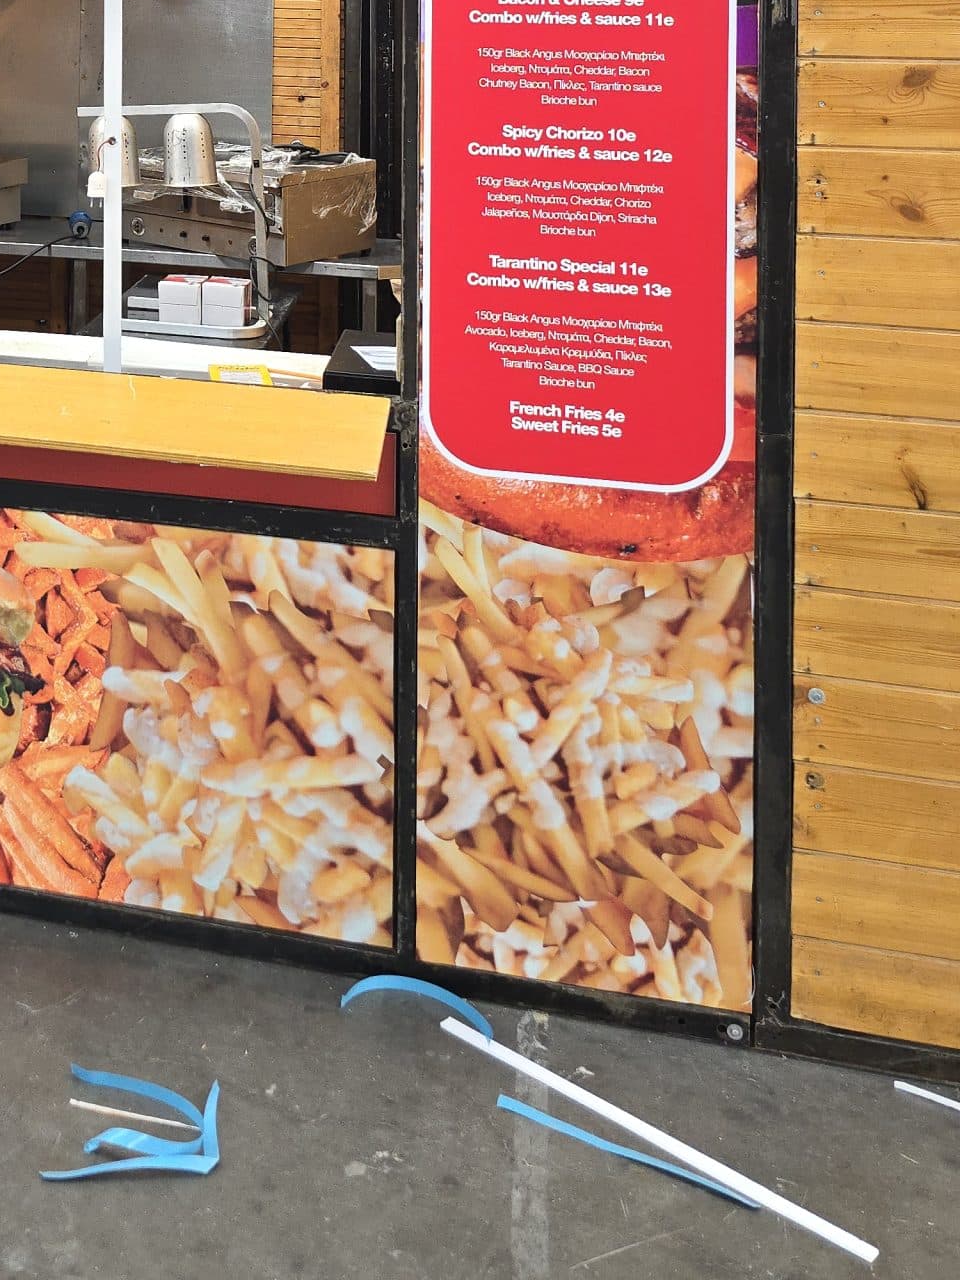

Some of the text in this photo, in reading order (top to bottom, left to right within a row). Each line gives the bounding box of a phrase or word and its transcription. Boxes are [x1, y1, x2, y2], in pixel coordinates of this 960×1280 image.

[469, 10, 674, 27] Combo w/fries & sauce 11e
[477, 47, 504, 60] 150gr
[505, 48, 531, 59] Black
[532, 49, 563, 61] Angus
[490, 64, 527, 75] Iceberg,
[573, 65, 617, 77] Cheddar,
[618, 66, 650, 76] Bacon
[478, 78, 518, 90] Chutney
[519, 79, 553, 91] Bacon,
[589, 81, 632, 92] Tarantino
[632, 83, 663, 93] sauce
[541, 94, 597, 106] Brioche bun
[502, 124, 637, 142] Spicy Chorizo 10e
[467, 142, 673, 163] Combo w/fries & sauce 12e
[475, 176, 503, 189] 150gr
[503, 178, 530, 188] Black
[530, 179, 562, 191] Angus
[487, 192, 523, 204] Iceberg,
[570, 195, 613, 207] Cheddar,
[614, 197, 652, 209] Chorizo
[481, 206, 531, 220] Jalapeños,
[590, 211, 616, 224] Dijon,
[617, 213, 657, 225] Sriracha
[540, 224, 596, 237] Brioche bun
[489, 254, 649, 277] Tarantino Special 11e
[466, 272, 672, 297] Combo w/fries & sauce 13e
[474, 310, 502, 323] 150gr
[502, 312, 529, 323] Black
[529, 314, 561, 327] Angus
[464, 324, 509, 337] Avocado,
[509, 327, 547, 341] Iceberg,
[593, 333, 637, 347] Cheddar,
[638, 336, 673, 350] Bacon,
[501, 357, 635, 377] Tarantino Sauce, BBQ Sauce
[538, 375, 596, 390] Brioche bun
[509, 400, 626, 423] French Fries 4e
[511, 416, 623, 438] Sweet Fries 5e
